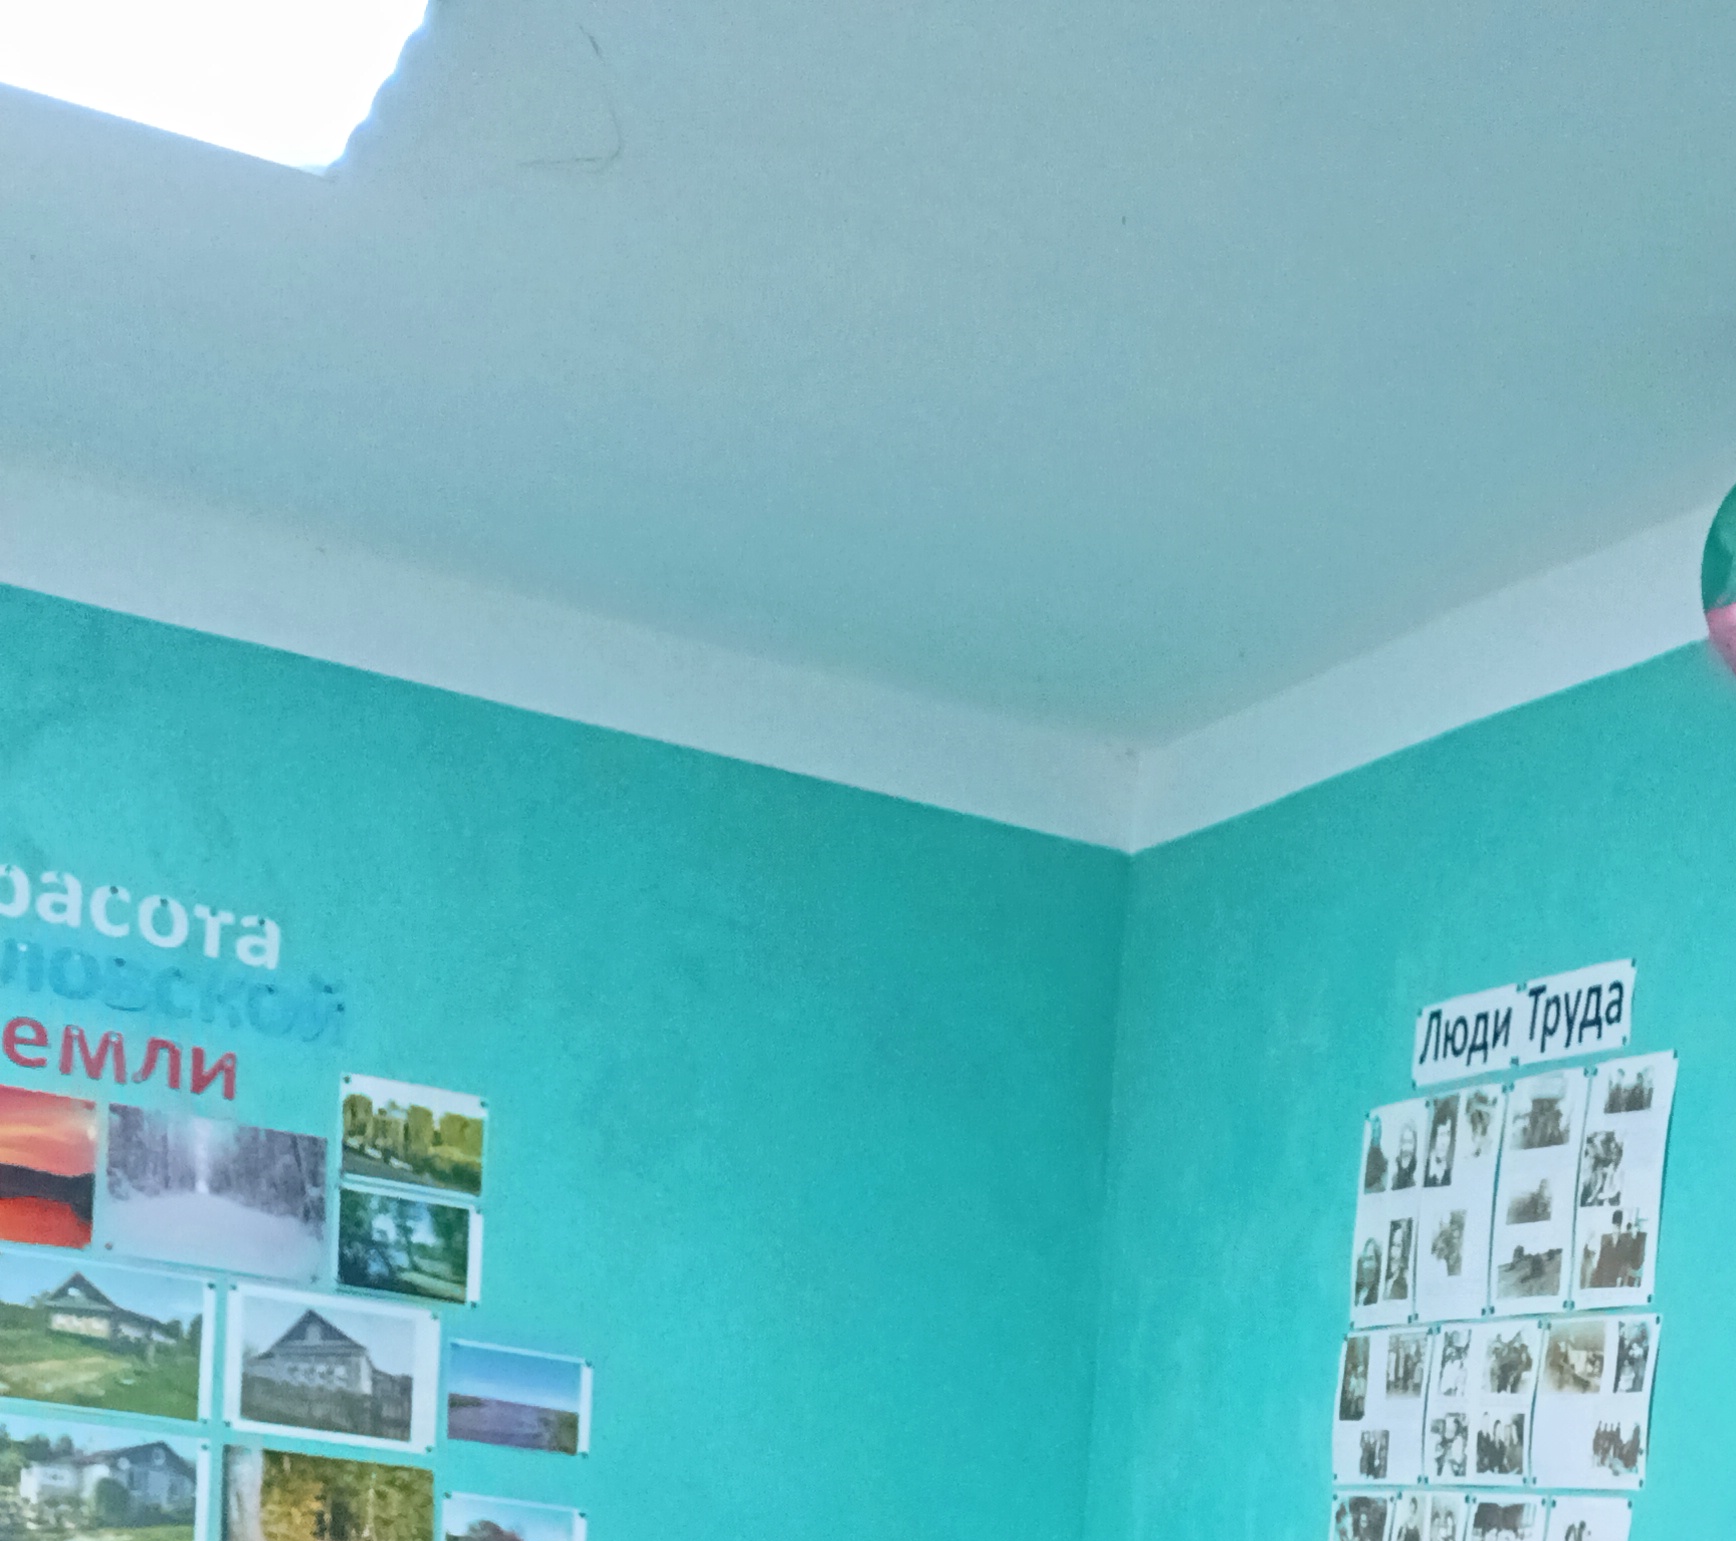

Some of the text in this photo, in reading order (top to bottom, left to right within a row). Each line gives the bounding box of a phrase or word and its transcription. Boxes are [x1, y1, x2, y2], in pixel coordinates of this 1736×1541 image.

[2, 1016, 236, 1101] емли
[1419, 980, 1624, 1066] Люди Труда
